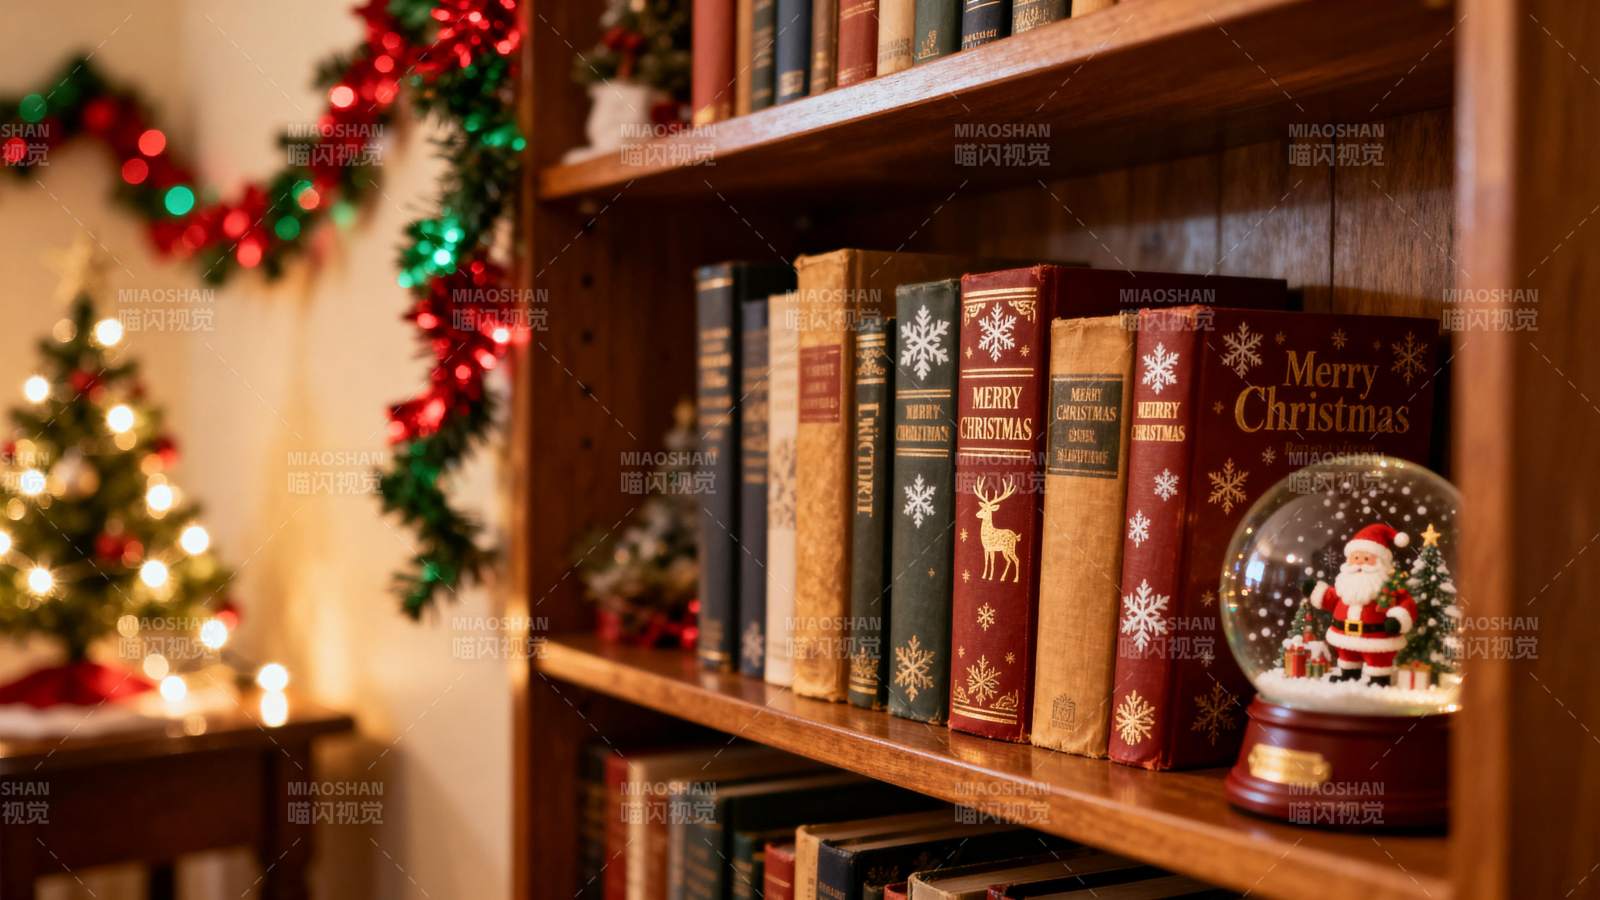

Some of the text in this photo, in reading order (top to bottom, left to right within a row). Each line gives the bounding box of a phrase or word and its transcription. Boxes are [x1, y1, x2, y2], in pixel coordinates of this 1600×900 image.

[1283, 350, 1379, 400] Merry
[972, 386, 1022, 410] MERRY
[1234, 385, 1410, 433] Christmas
[1056, 405, 1117, 422] CHRISTMAS
[960, 416, 1032, 441] CHRISTMAS
